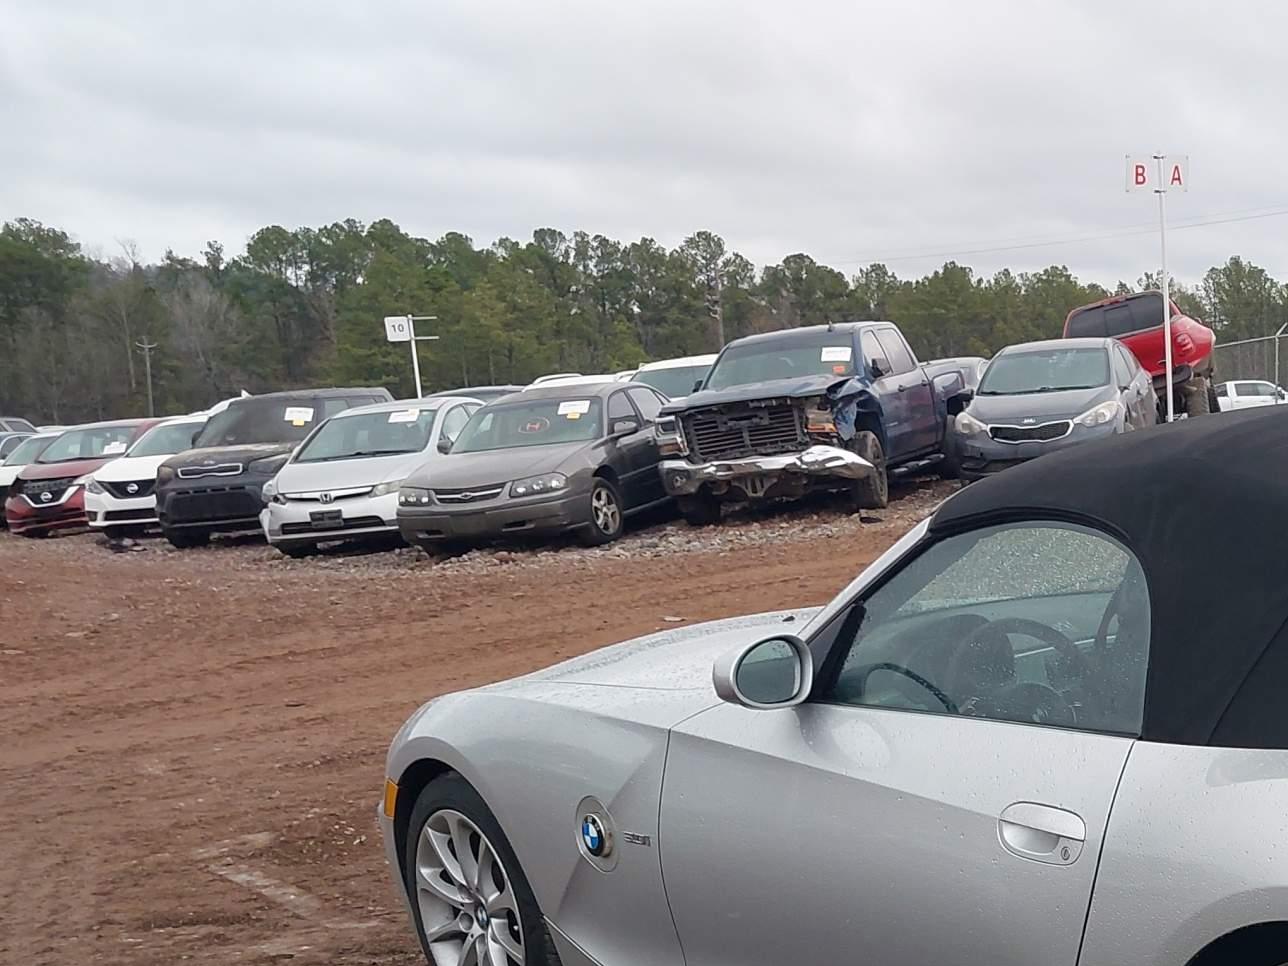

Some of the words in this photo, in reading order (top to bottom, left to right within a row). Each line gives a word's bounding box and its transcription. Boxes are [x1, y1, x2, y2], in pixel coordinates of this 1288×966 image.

[1135, 164, 1147, 186] B
[1170, 164, 1182, 186] A
[391, 323, 405, 333] 10
